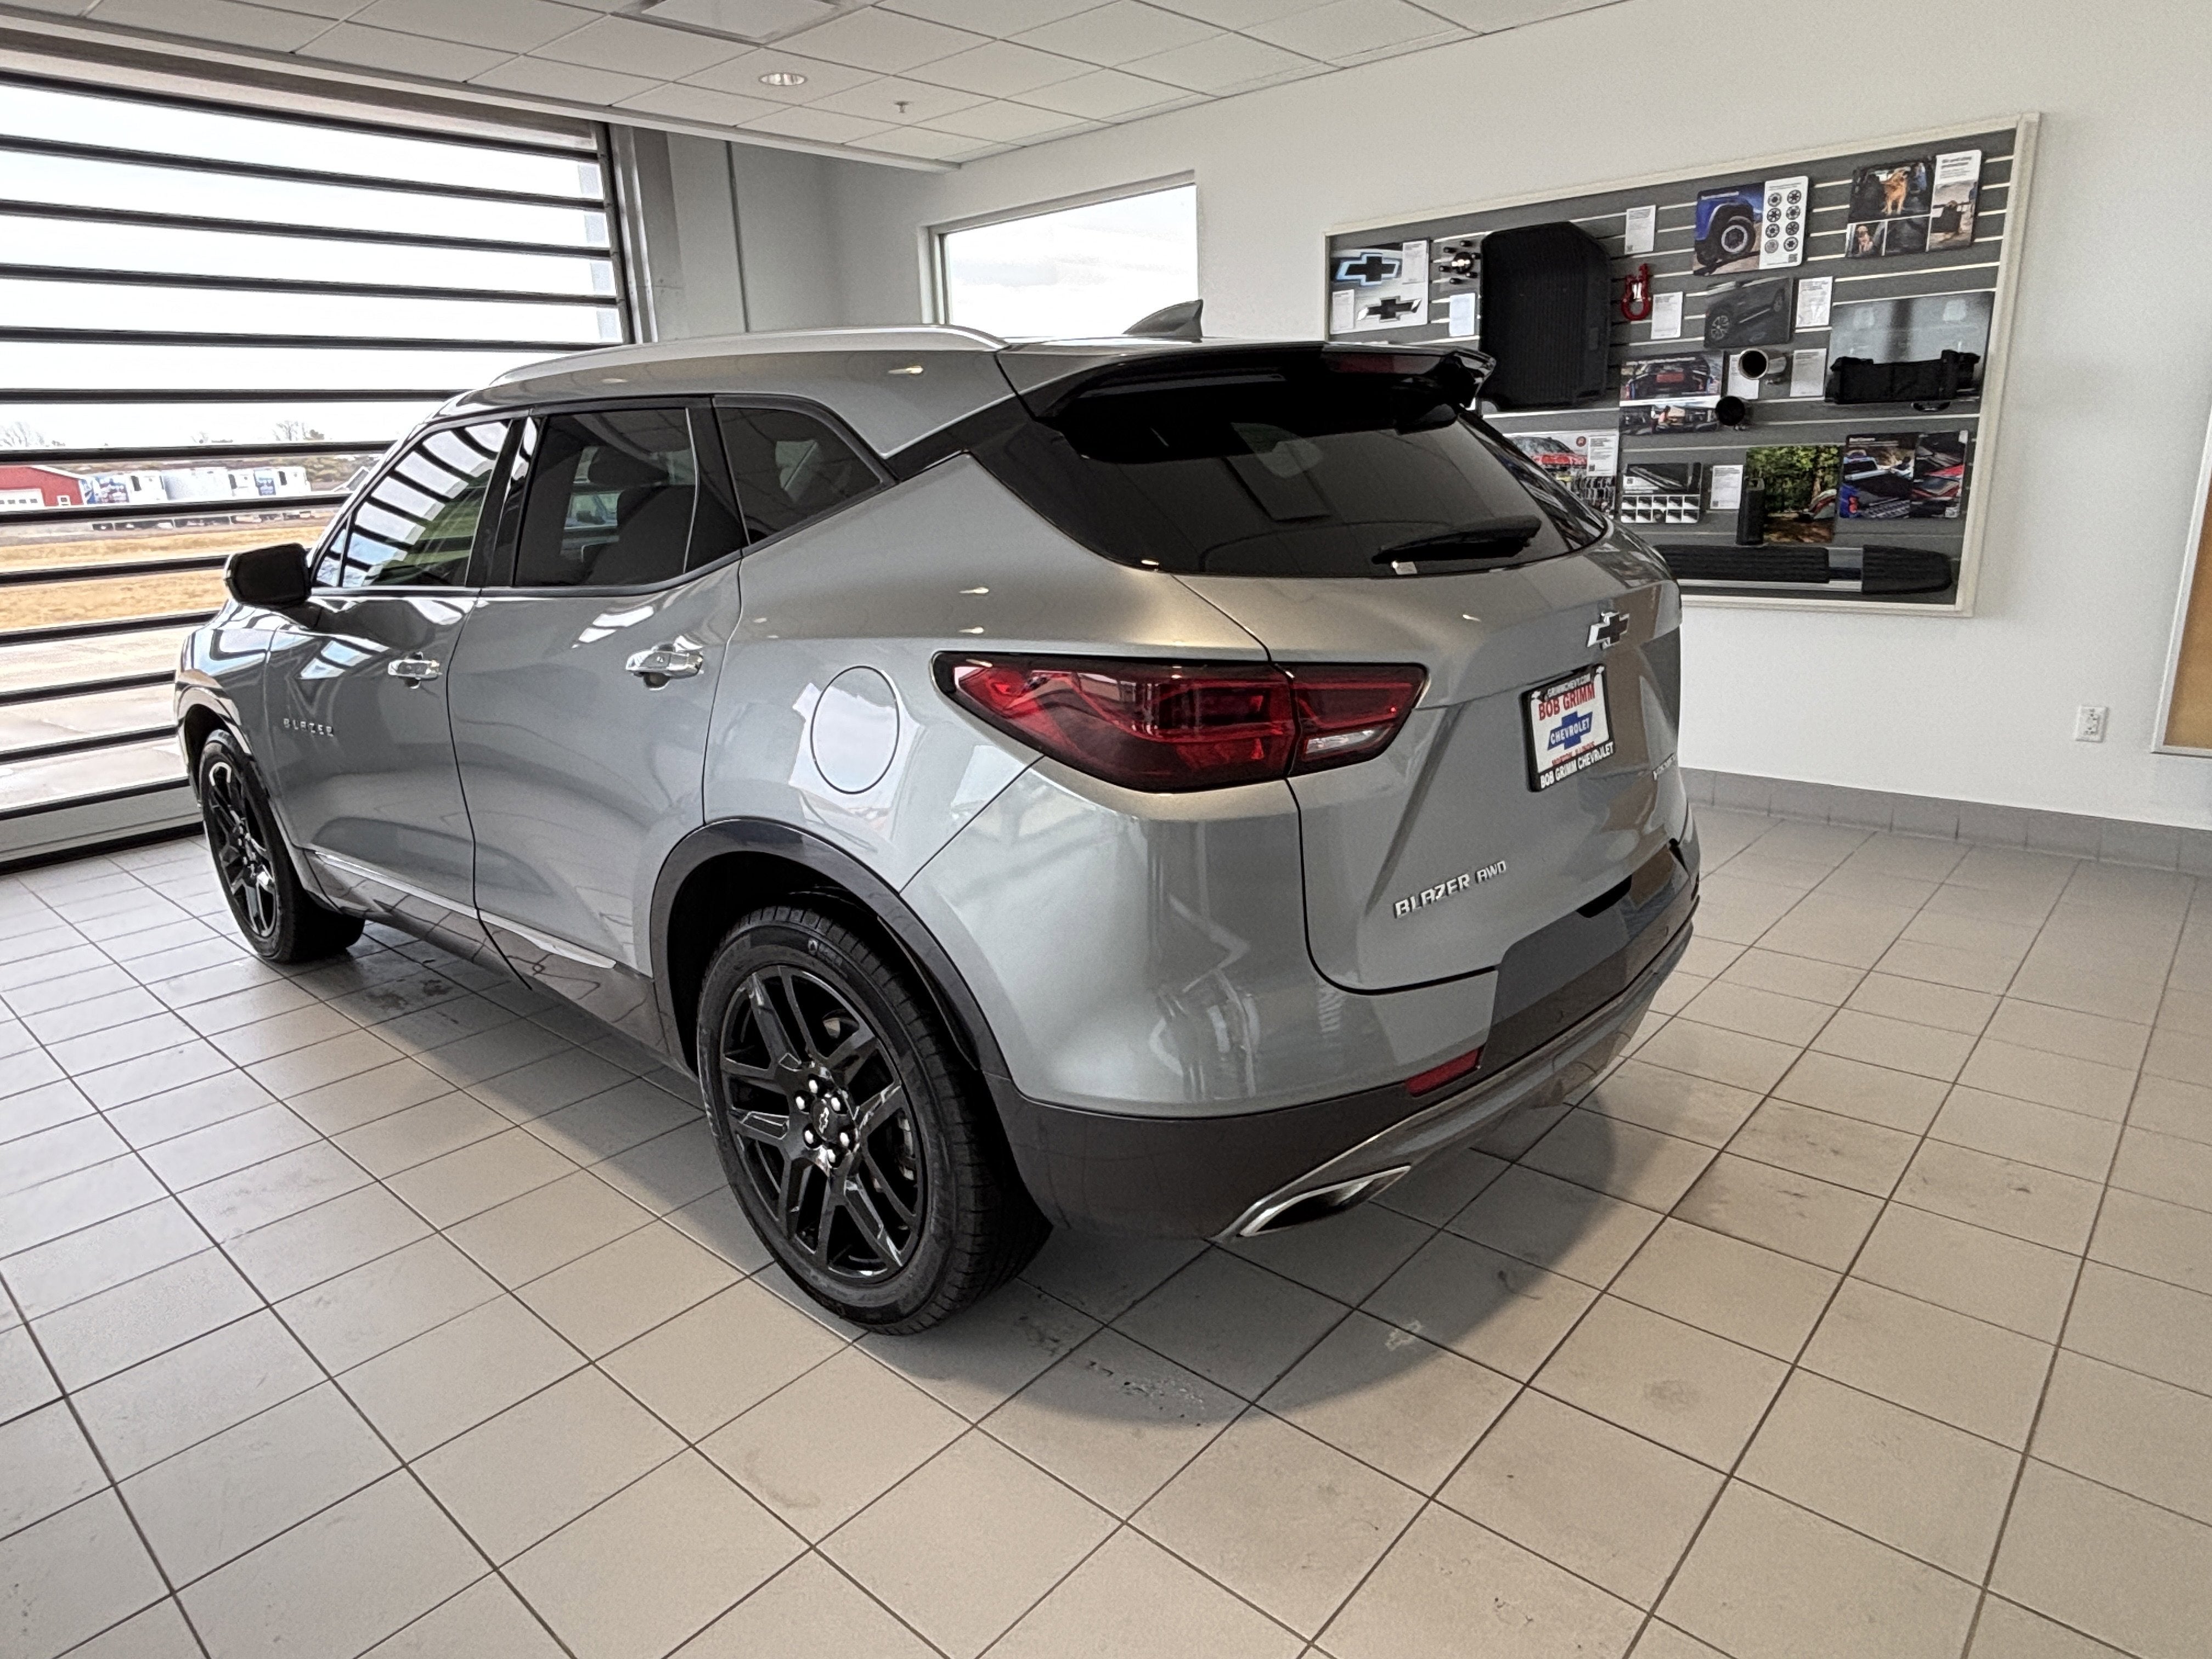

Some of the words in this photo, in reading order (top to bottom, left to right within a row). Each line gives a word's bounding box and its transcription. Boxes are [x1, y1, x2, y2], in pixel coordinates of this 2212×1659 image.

[1539, 697, 1560, 720] BOB
[1563, 682, 1595, 710] GRIMM
[283, 718, 334, 737] BLAZER
[1550, 718, 1590, 744] CHEVROLET
[1541, 770, 1555, 789] BOB
[1555, 759, 1578, 781] GRIMM
[1578, 741, 1613, 769] CHEVROLET
[1393, 873, 1470, 918] BLAZER
[1475, 860, 1506, 883] AWD
